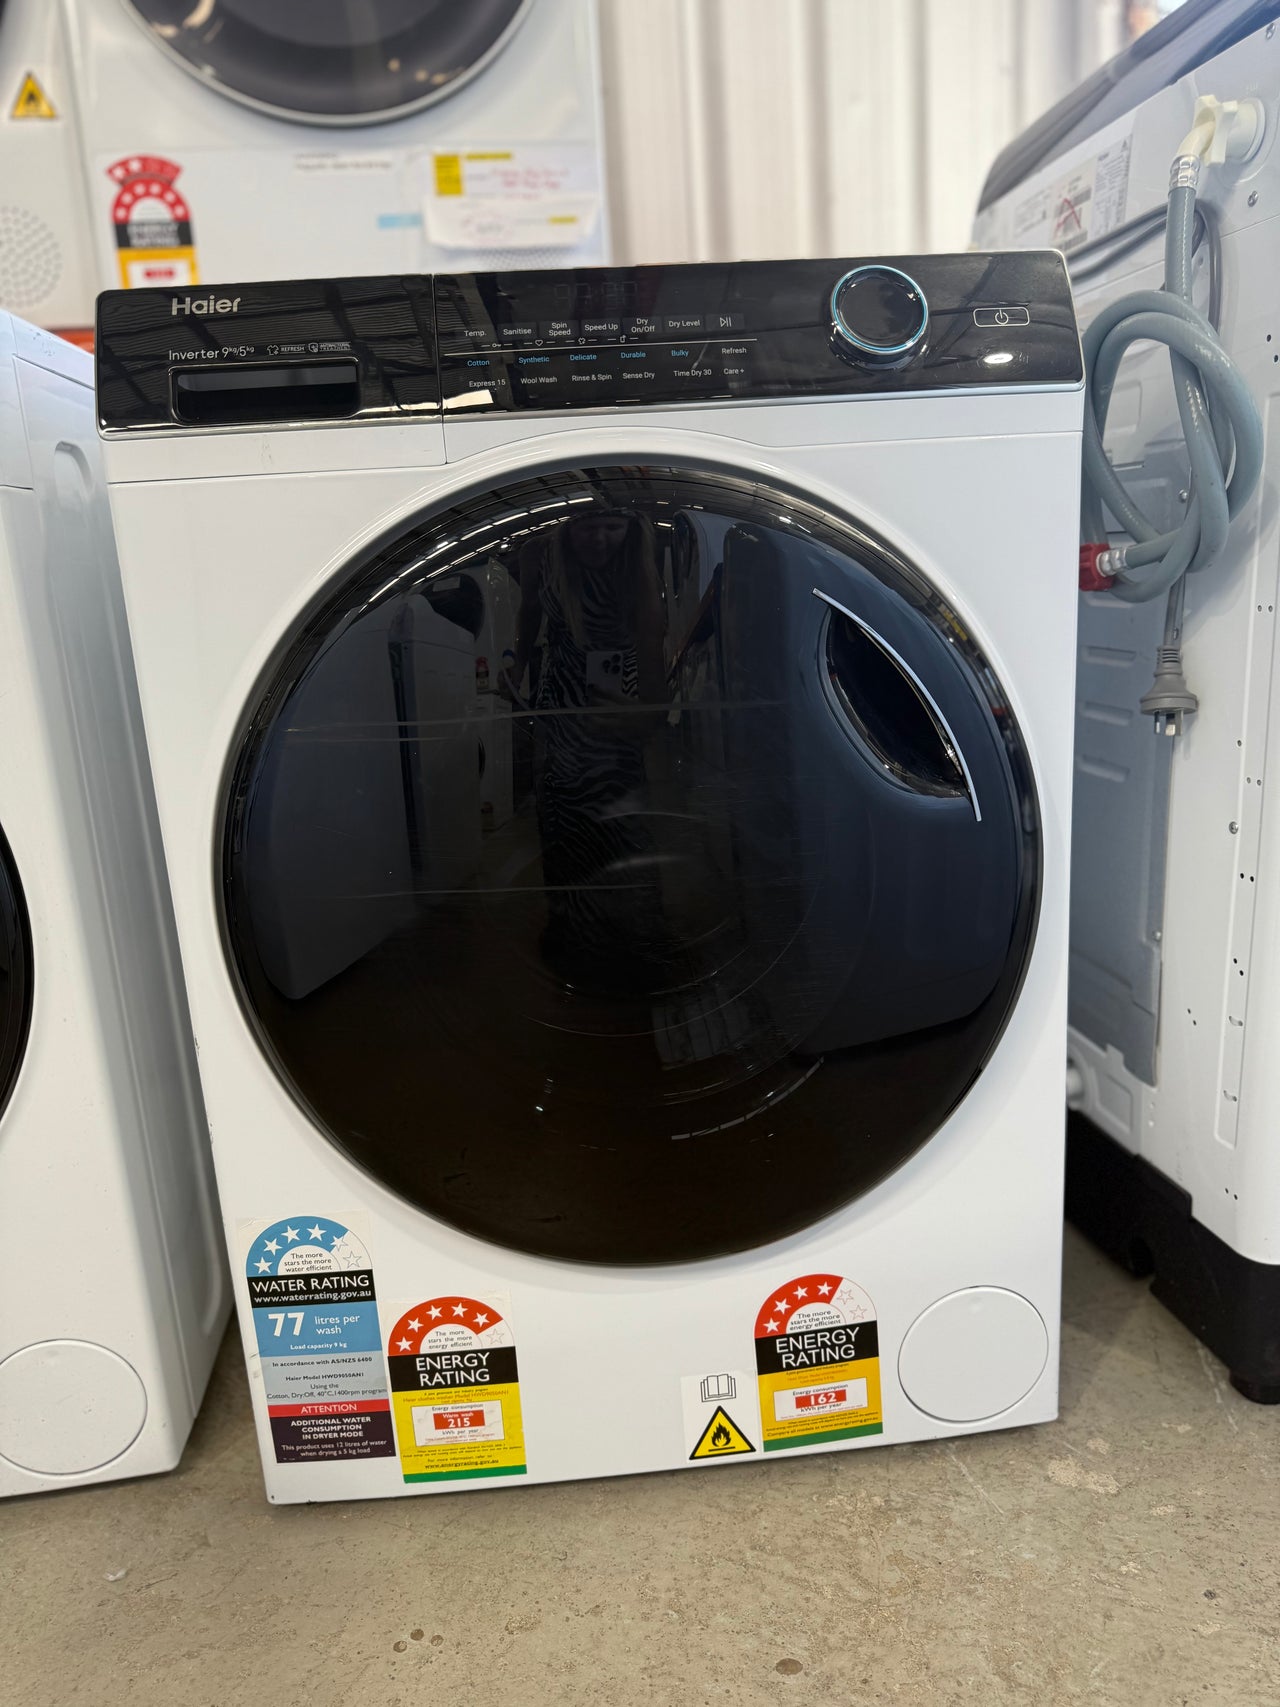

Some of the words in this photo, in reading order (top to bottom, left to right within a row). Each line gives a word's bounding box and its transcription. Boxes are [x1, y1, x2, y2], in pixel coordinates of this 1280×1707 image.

[171, 294, 241, 316] Haier
[551, 322, 567, 330] Spin
[584, 324, 607, 332] Speed
[609, 323, 619, 331] Up
[668, 320, 681, 328] Dry
[682, 319, 701, 327] Level
[503, 328, 532, 336] Sanitise
[549, 329, 571, 337] Speed
[631, 325, 656, 333] On/Off
[169, 349, 220, 361] Inverter
[620, 351, 647, 359] Durable
[518, 356, 550, 365] Synthetic
[571, 374, 590, 382] Rinse
[622, 372, 643, 380] Sense
[468, 380, 496, 388] Express
[252, 1279, 307, 1293] WATER
[310, 1274, 370, 1290] RATING
[254, 1289, 372, 1303] www.waterrating.gov.au
[268, 1312, 305, 1337] 77
[314, 1315, 340, 1325] litres
[343, 1315, 361, 1325] per
[814, 1319, 841, 1327] efficient
[316, 1325, 342, 1335] wash
[775, 1326, 860, 1353] ENERGY
[781, 1344, 855, 1368] RATING
[415, 1352, 490, 1371] ENERGY
[419, 1368, 490, 1387] RATING
[361, 1388, 387, 1396] program
[812, 1384, 848, 1393] consumption
[810, 1392, 837, 1406] 162
[300, 1403, 358, 1414] ATTENTION
[290, 1419, 341, 1427] ADDITIONAL
[447, 1417, 471, 1428] 215
[301, 1424, 362, 1433] CONSUMPTION
[296, 1443, 320, 1451] product
